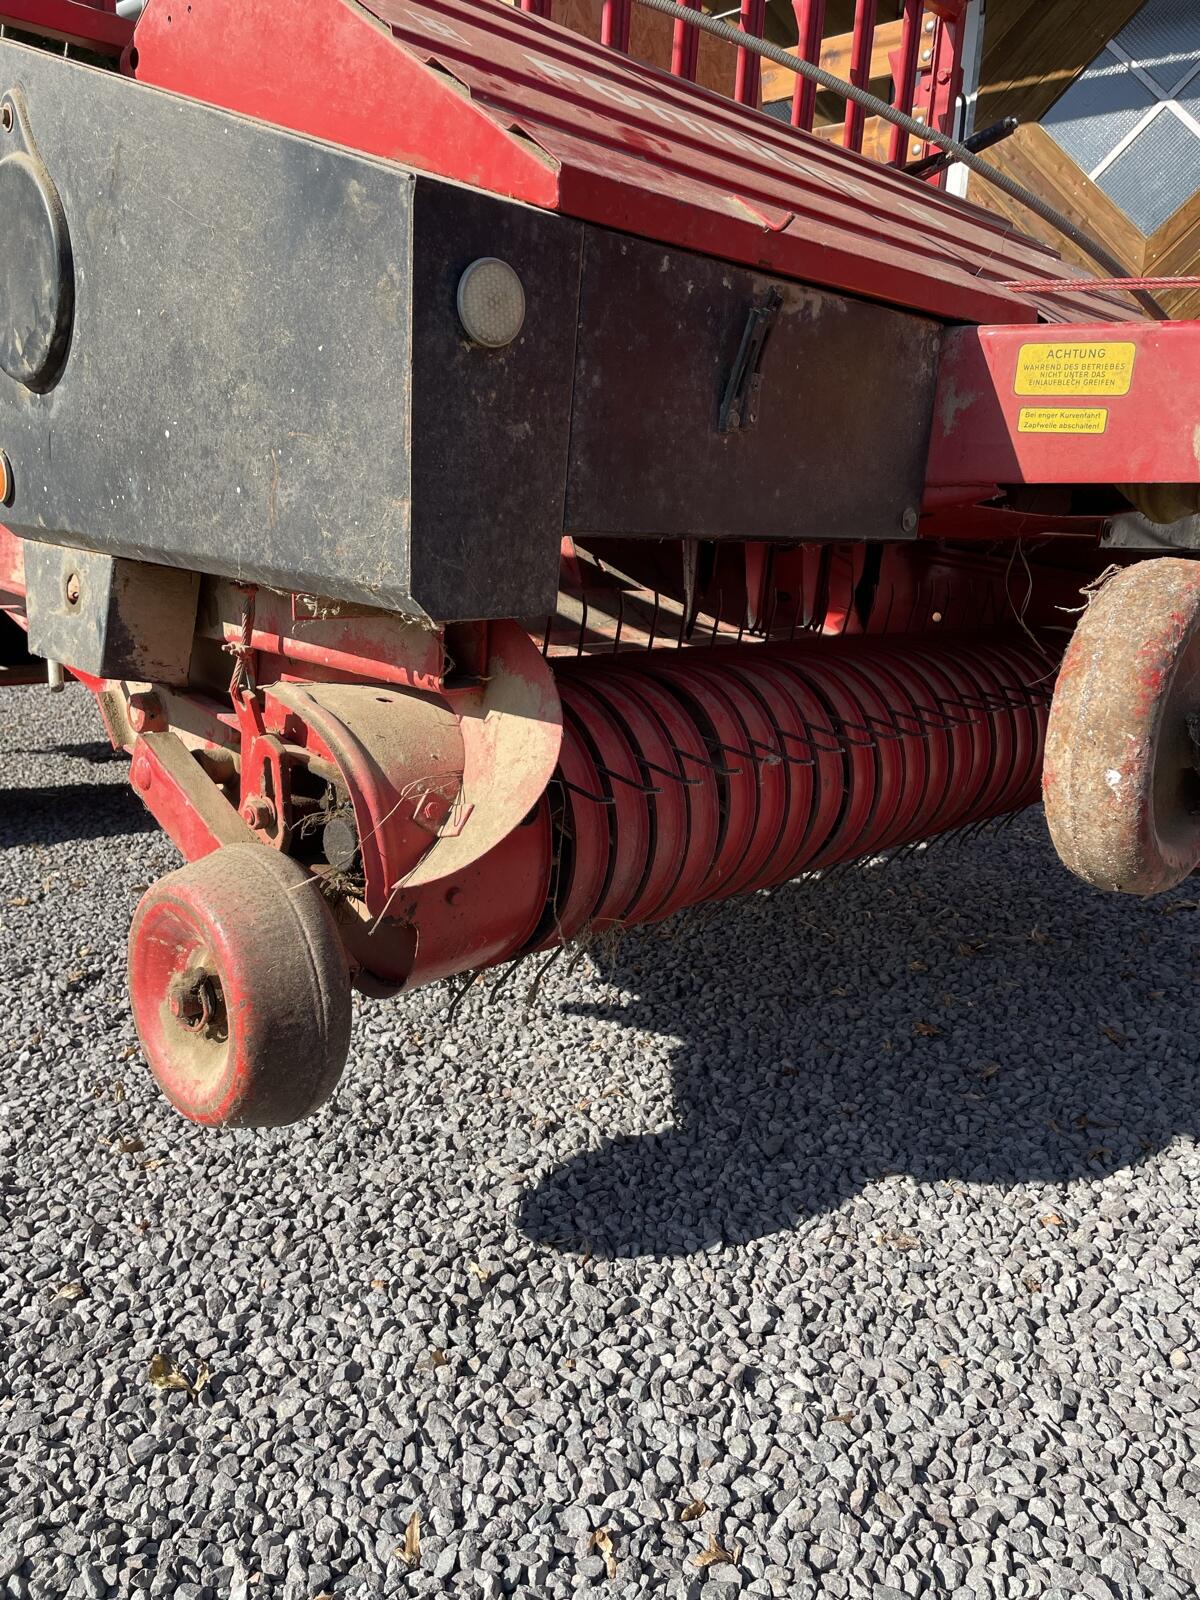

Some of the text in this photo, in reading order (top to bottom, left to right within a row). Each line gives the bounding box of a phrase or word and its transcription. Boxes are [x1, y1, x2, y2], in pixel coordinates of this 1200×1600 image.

[1047, 348, 1106, 359] ACHTUNG
[1063, 363, 1079, 371] DES
[1081, 362, 1126, 371] BETRIEBES
[1060, 411, 1101, 419] Kurvenfahrt
